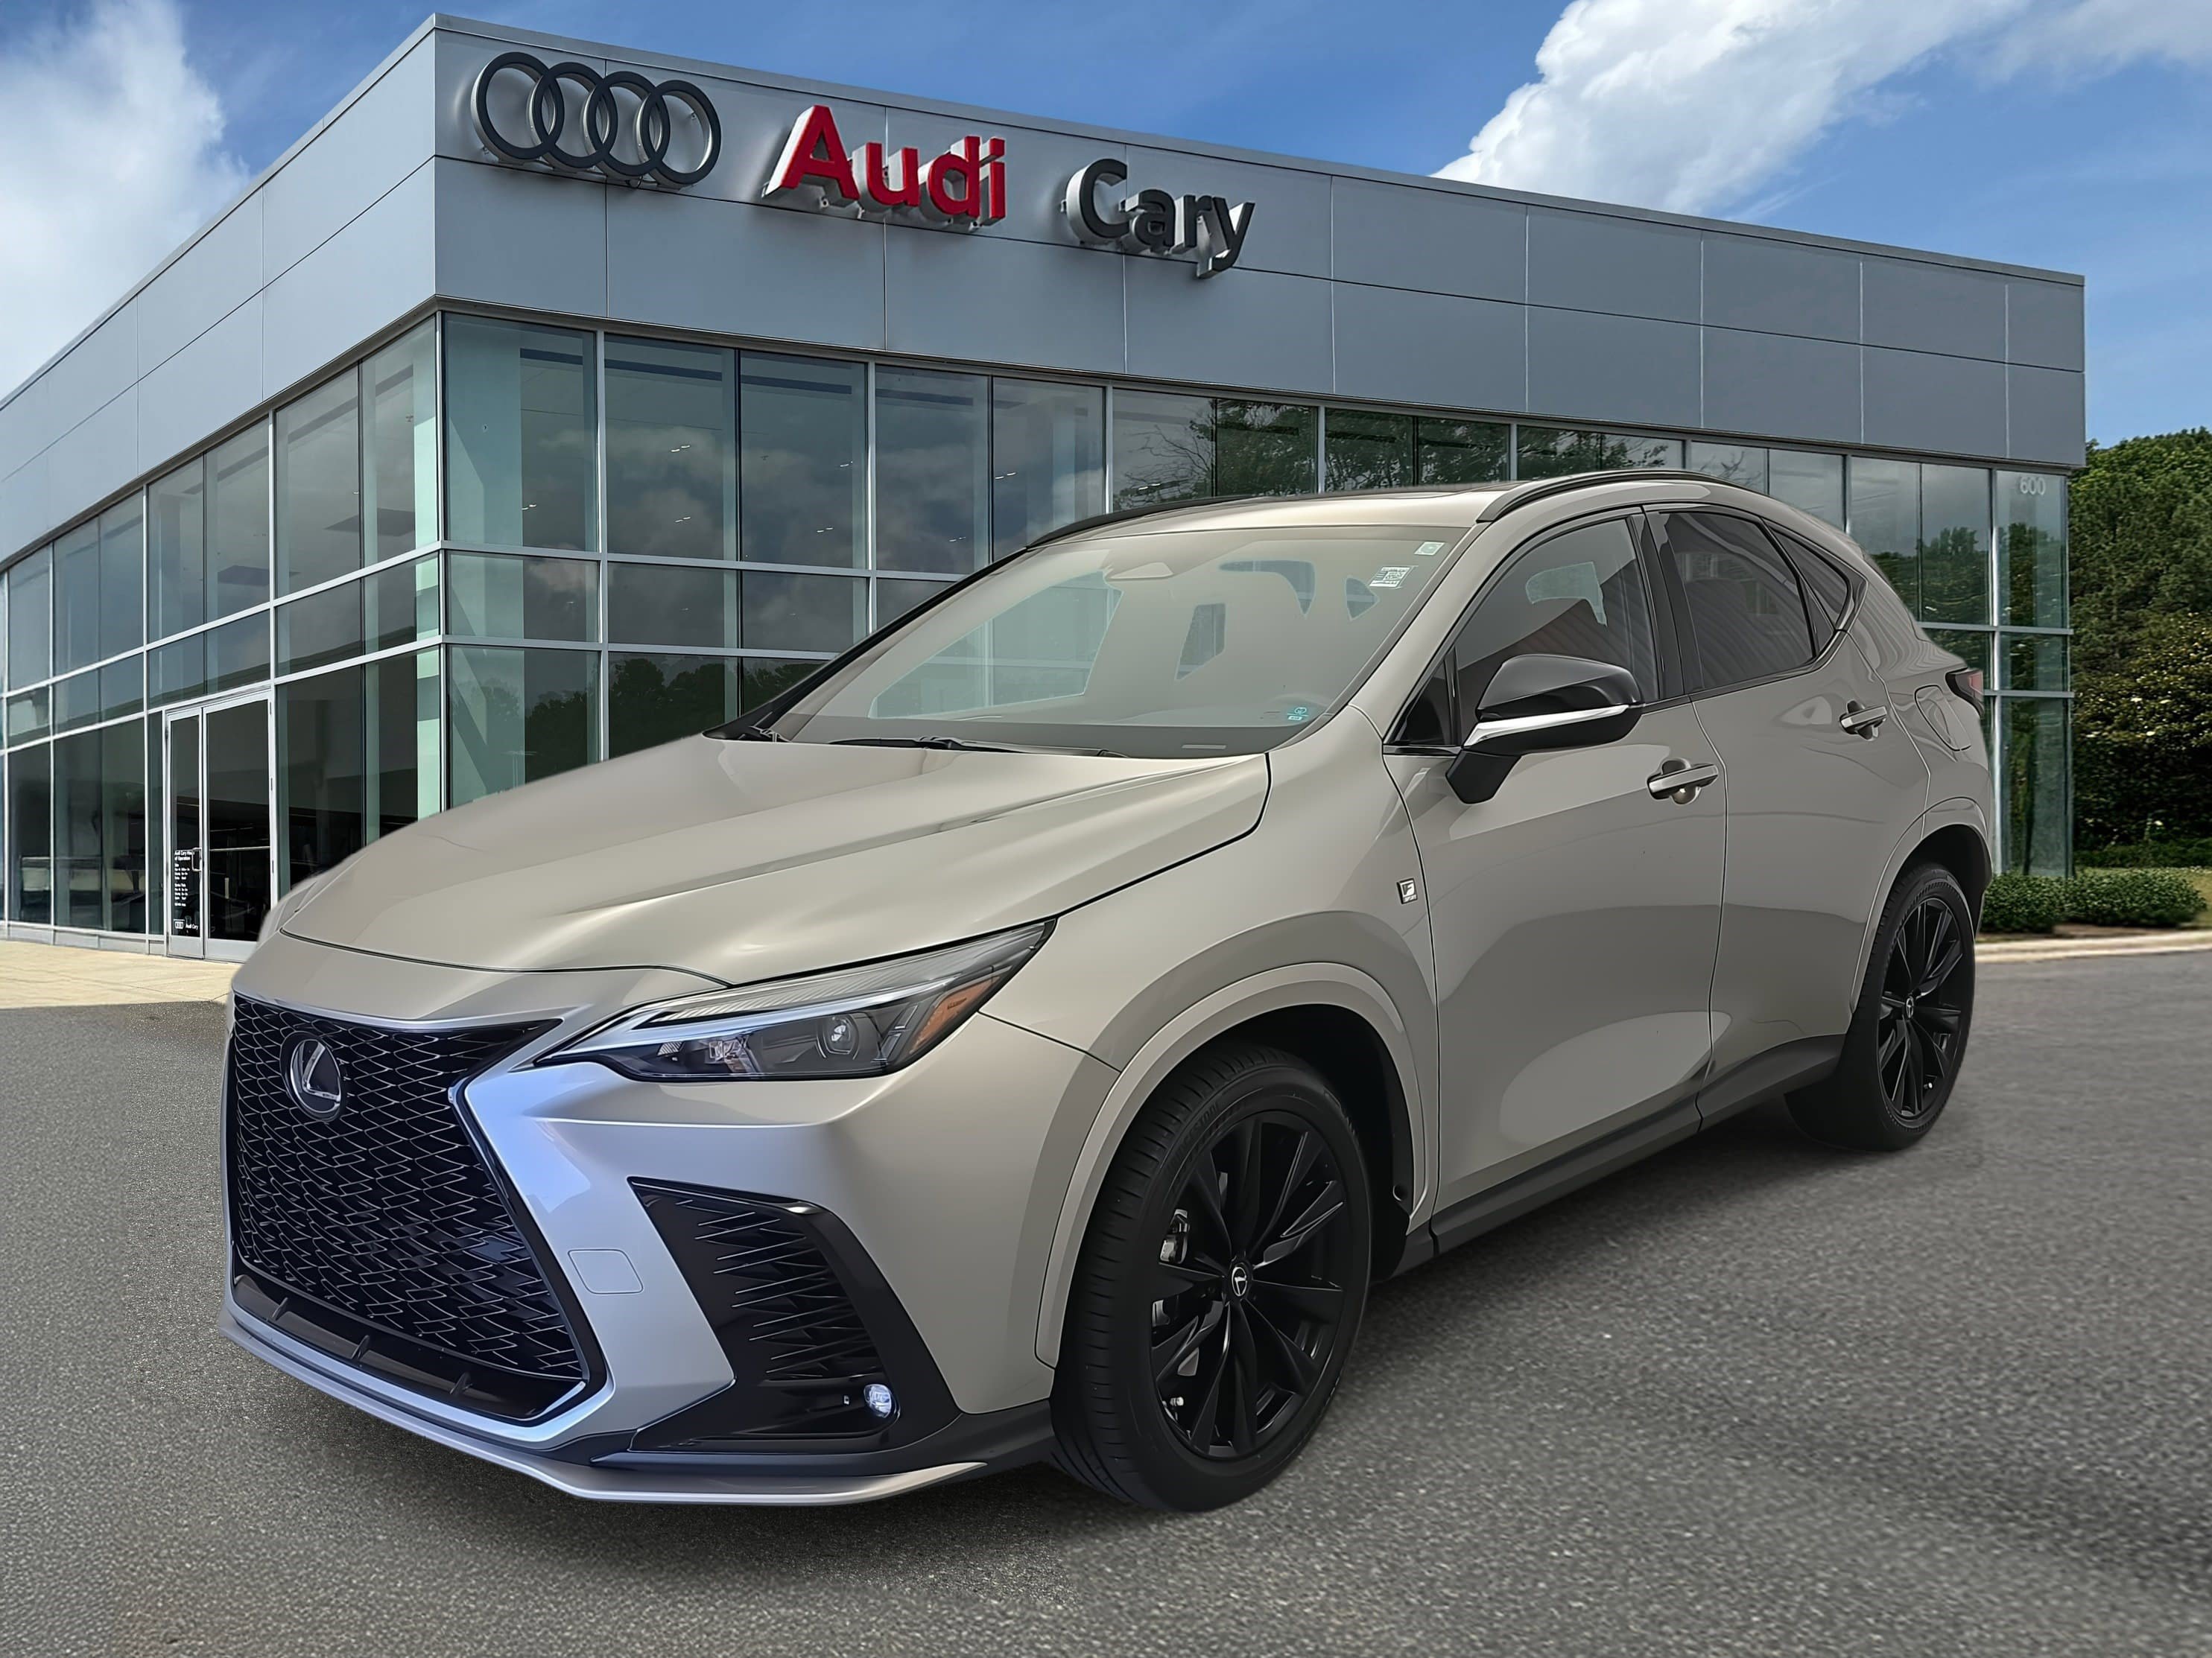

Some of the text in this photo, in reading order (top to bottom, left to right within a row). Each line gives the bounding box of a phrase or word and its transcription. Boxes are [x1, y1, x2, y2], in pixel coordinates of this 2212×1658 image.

[775, 105, 1256, 275] Audi Cary
[2020, 477, 2046, 495] 600
